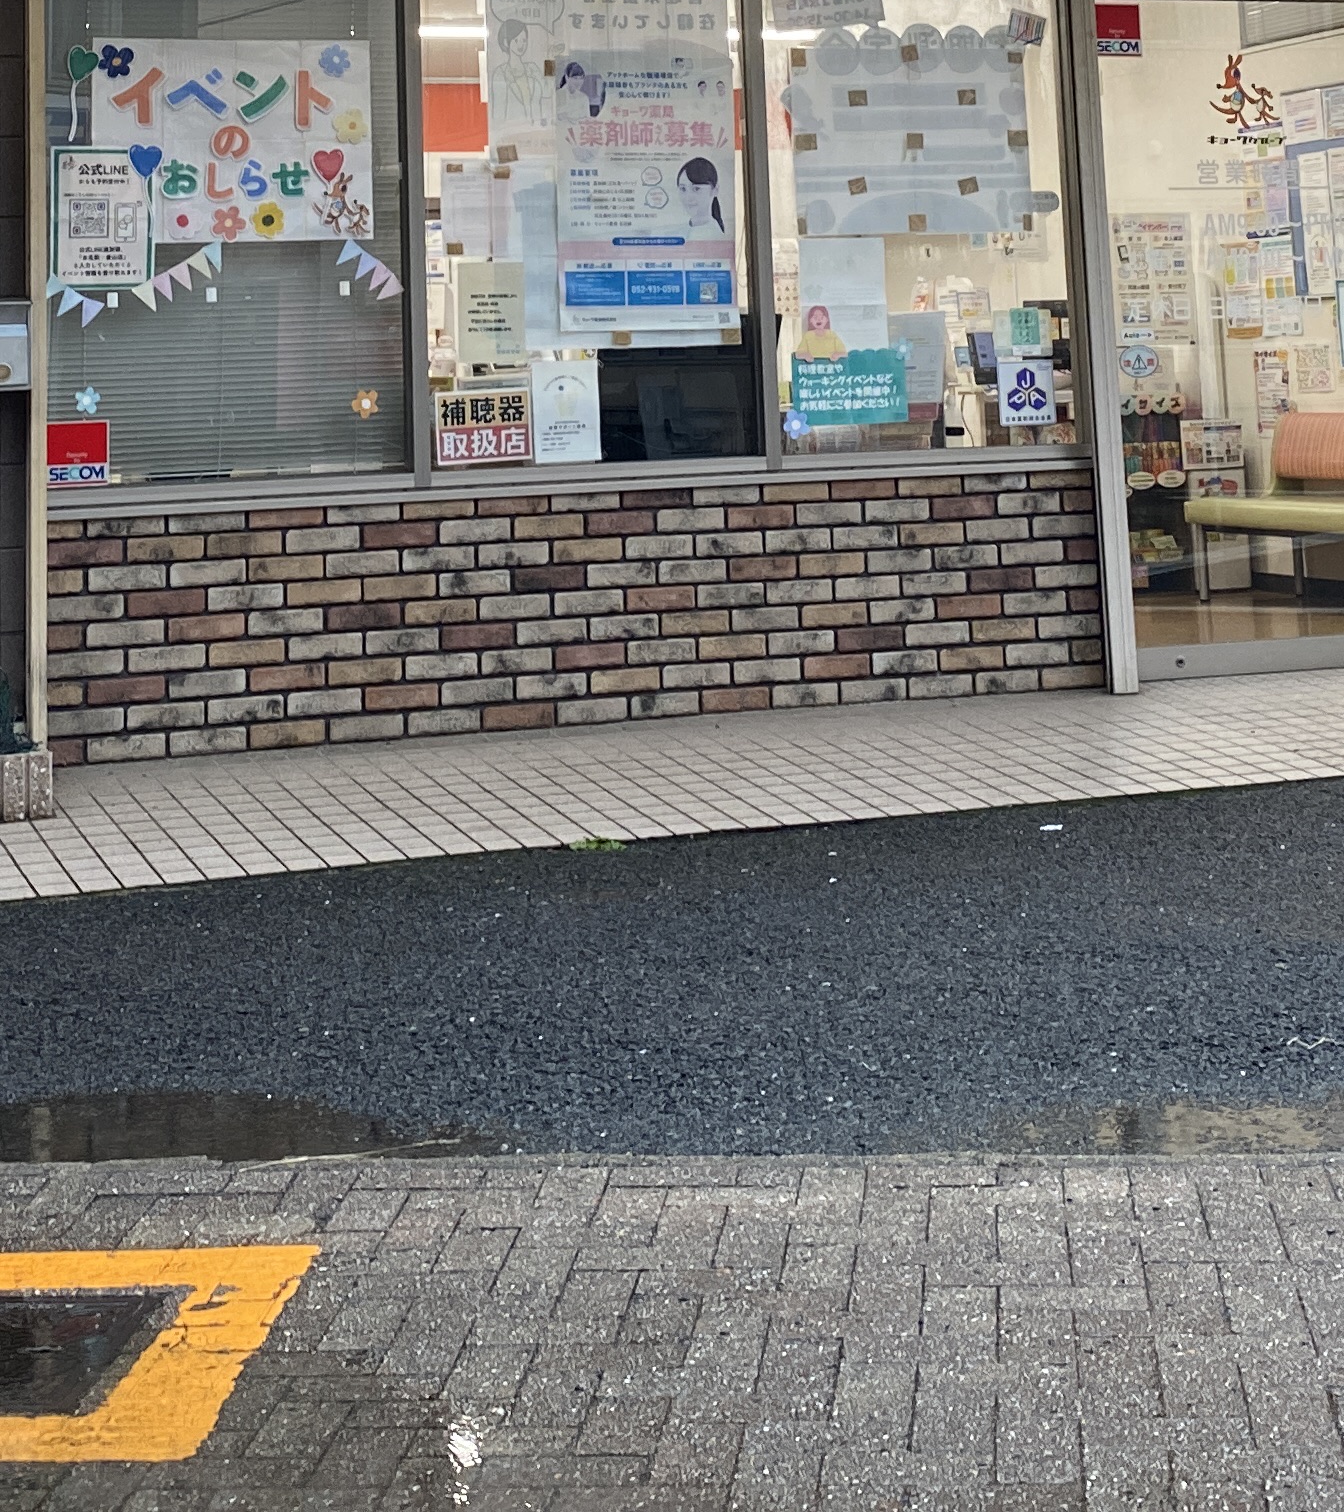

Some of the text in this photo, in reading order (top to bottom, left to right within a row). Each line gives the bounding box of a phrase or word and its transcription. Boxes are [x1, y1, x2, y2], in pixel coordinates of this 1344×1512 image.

[1097, 40, 1139, 53] SECOM
[110, 67, 335, 131] イベント
[610, 105, 674, 118] キョーワ薬局
[211, 125, 251, 160] の
[1207, 135, 1287, 145] キョーワグループ
[78, 164, 129, 176] 公式LINE
[160, 159, 310, 202] おしらせ
[441, 395, 525, 426] 補聴器
[442, 427, 526, 458] 取扱店
[49, 465, 105, 481] SECOM
